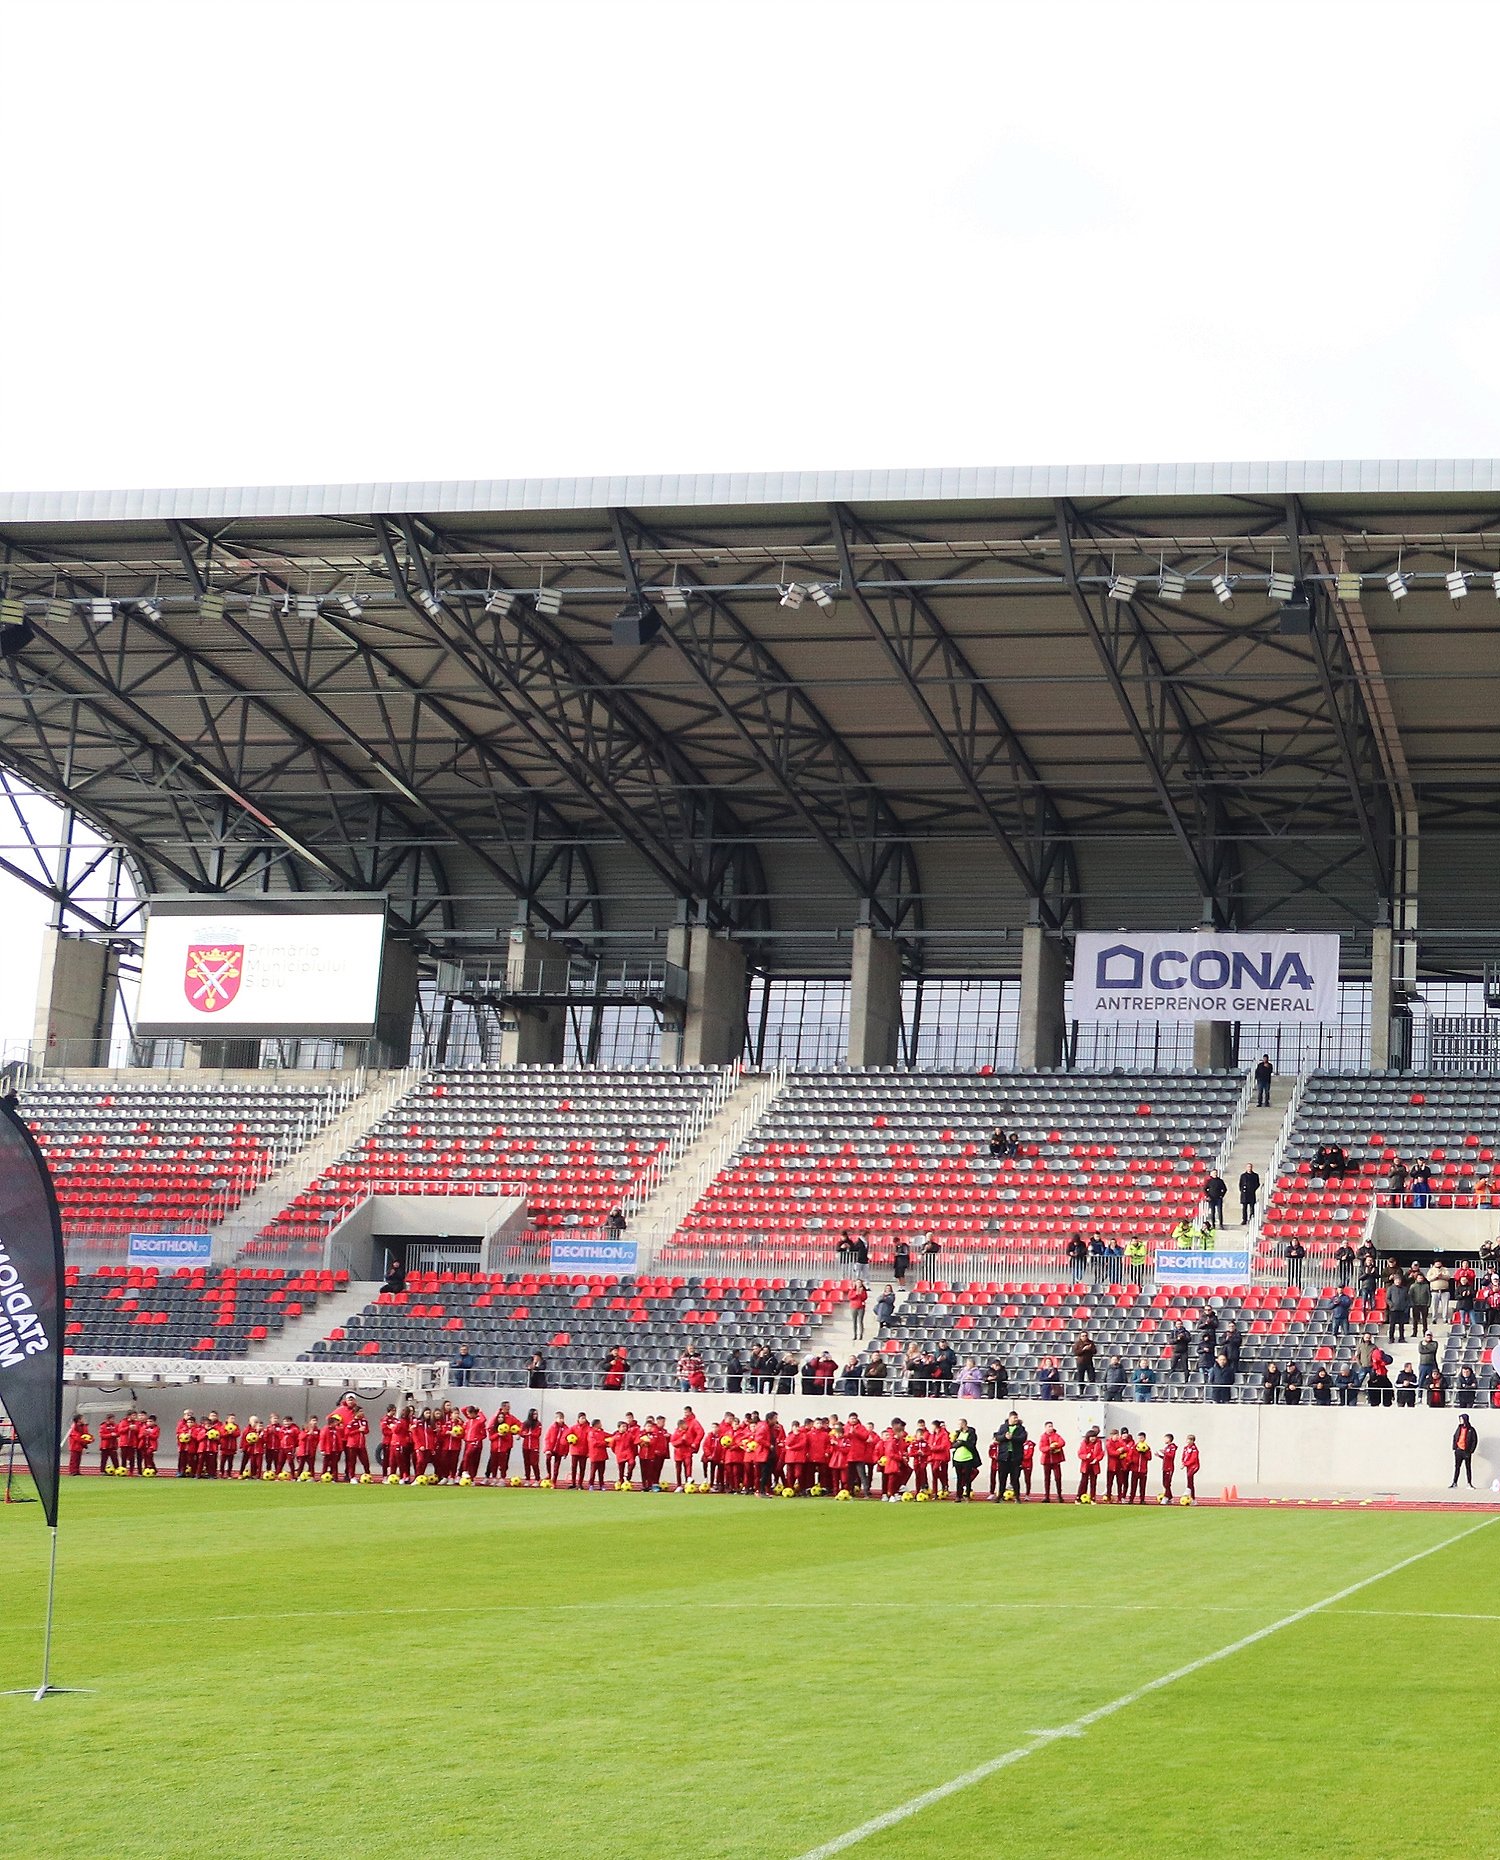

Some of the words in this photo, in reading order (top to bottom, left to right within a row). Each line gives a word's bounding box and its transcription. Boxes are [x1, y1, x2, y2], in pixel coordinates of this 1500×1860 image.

[1150, 950, 1314, 990] CONA
[1095, 996, 1227, 1011] ANTREPRENOR
[1232, 997, 1314, 1012] GENERAL
